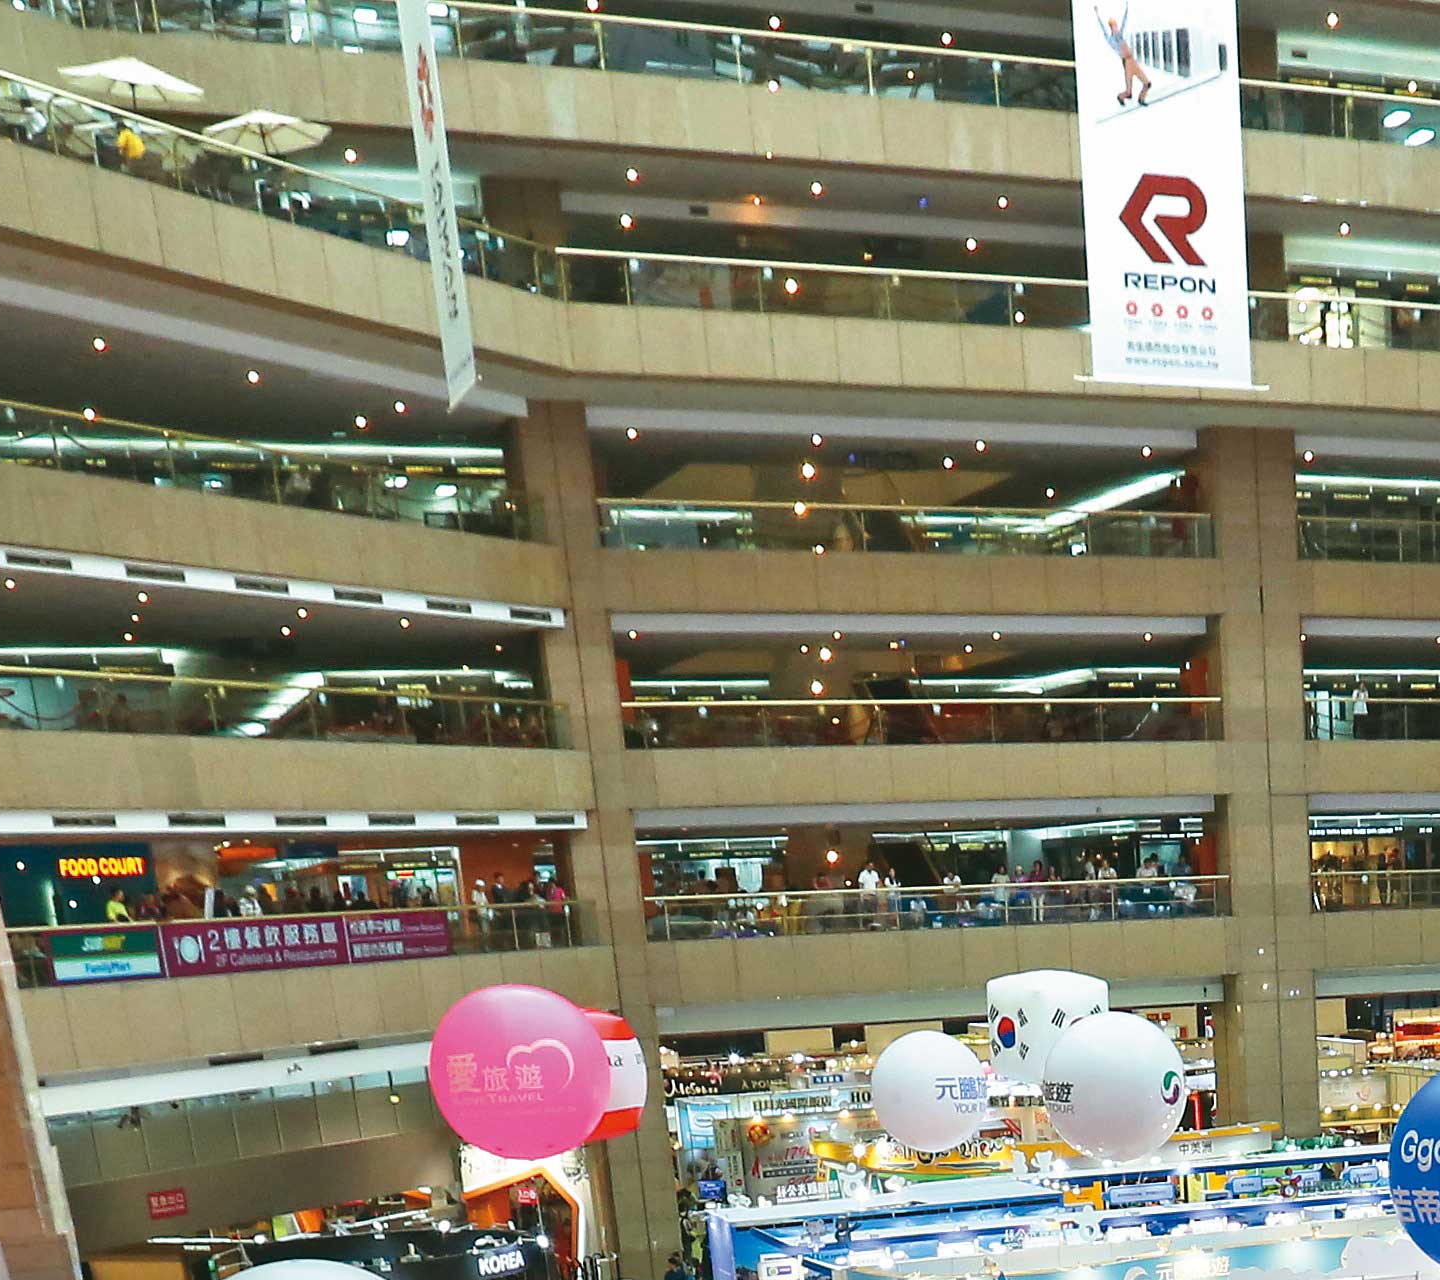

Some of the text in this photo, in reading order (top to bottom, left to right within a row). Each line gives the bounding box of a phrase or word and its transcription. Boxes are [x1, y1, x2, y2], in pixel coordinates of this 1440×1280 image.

[1124, 271, 1217, 295] REPON
[59, 857, 145, 878] FOOD COURT
[478, 1246, 527, 1278] KOREA
